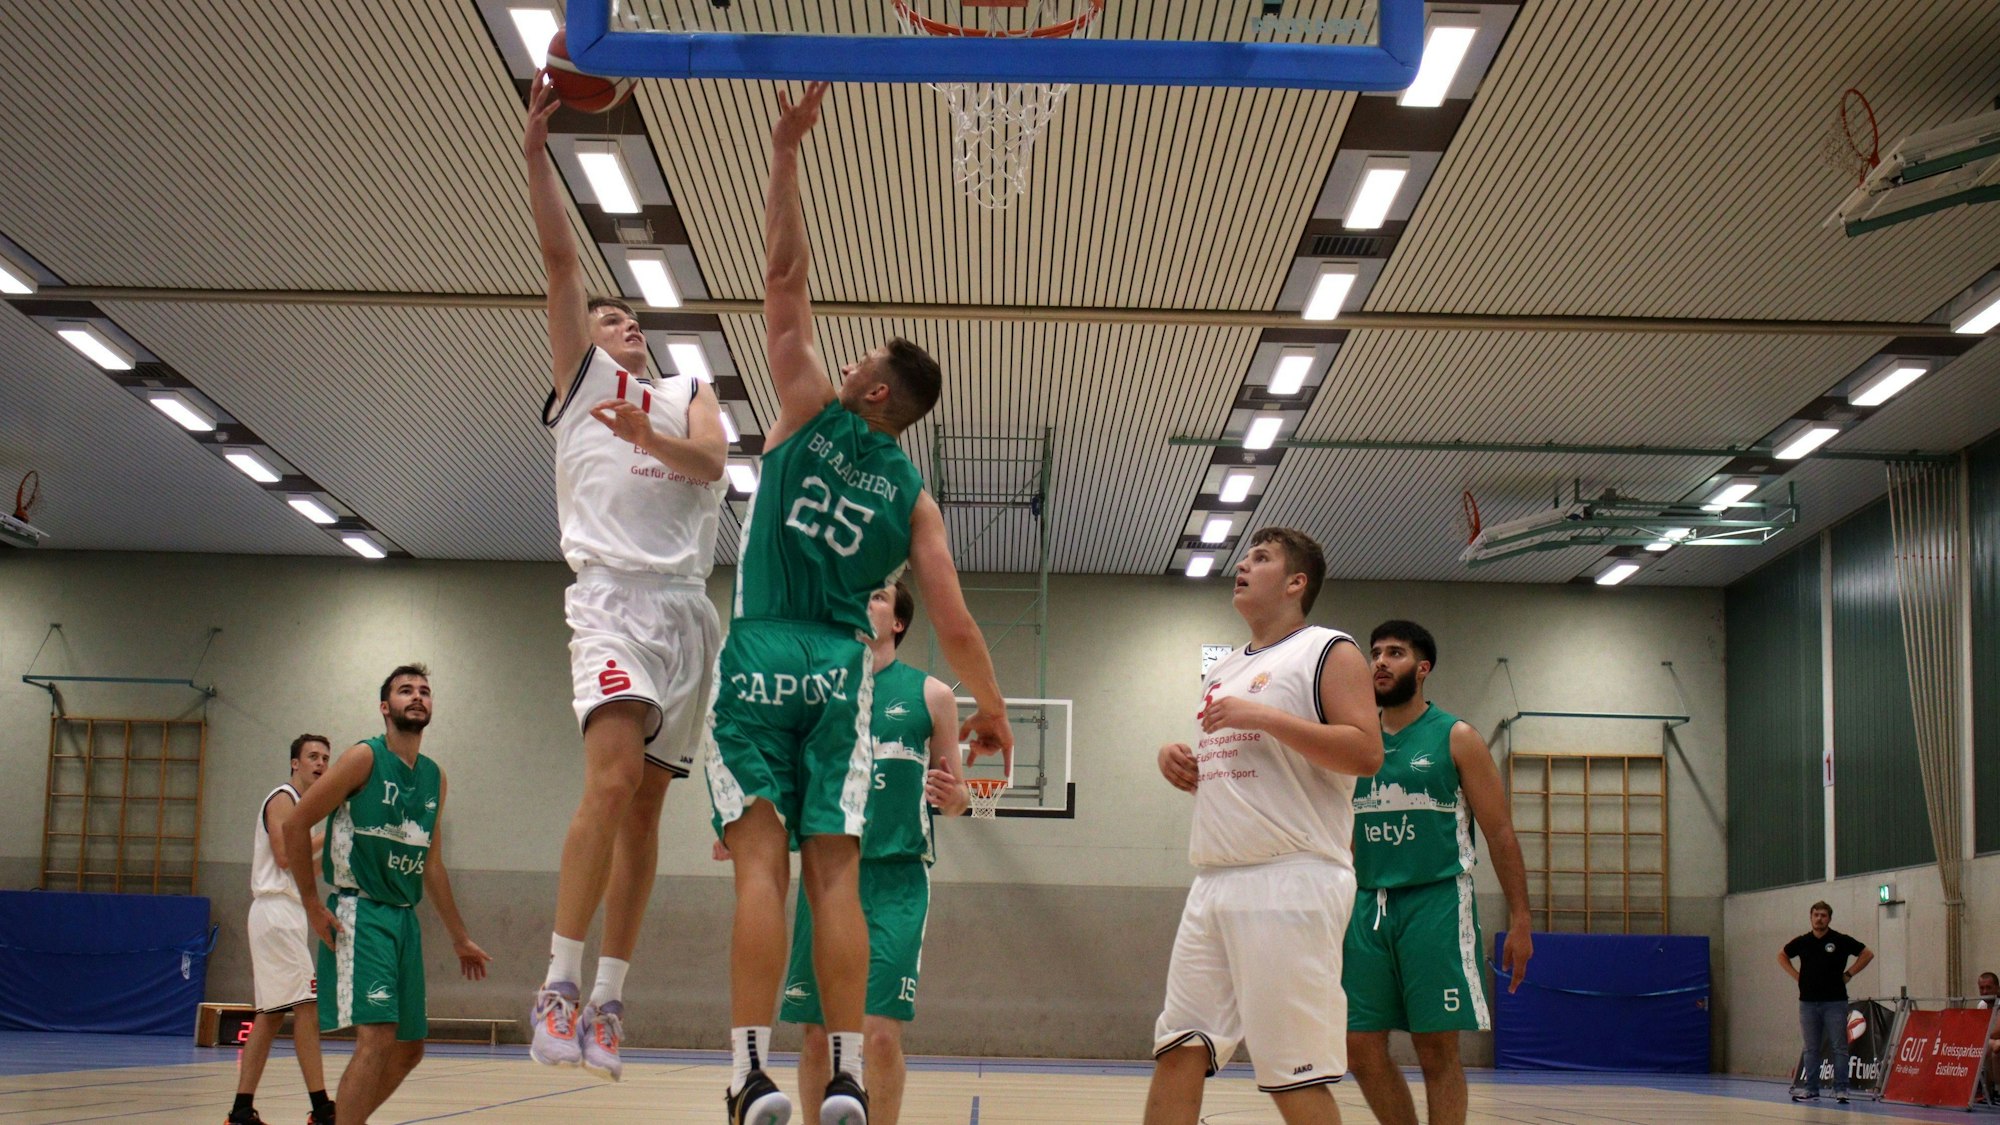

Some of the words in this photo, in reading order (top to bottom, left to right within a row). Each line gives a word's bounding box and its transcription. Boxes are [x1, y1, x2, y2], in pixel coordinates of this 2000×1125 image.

[630, 465, 649, 477] Gut
[651, 467, 666, 479] für
[667, 471, 686, 482] den
[808, 432, 830, 460] BG
[827, 451, 898, 503] AACHEN
[785, 475, 875, 558] 25
[1231, 768, 1259, 780] Sport.
[898, 976, 917, 1002] 15
[1444, 988, 1461, 1012] 5
[1293, 1063, 1313, 1076] JAKO
[1935, 1062, 1969, 1077] Euskirchen
